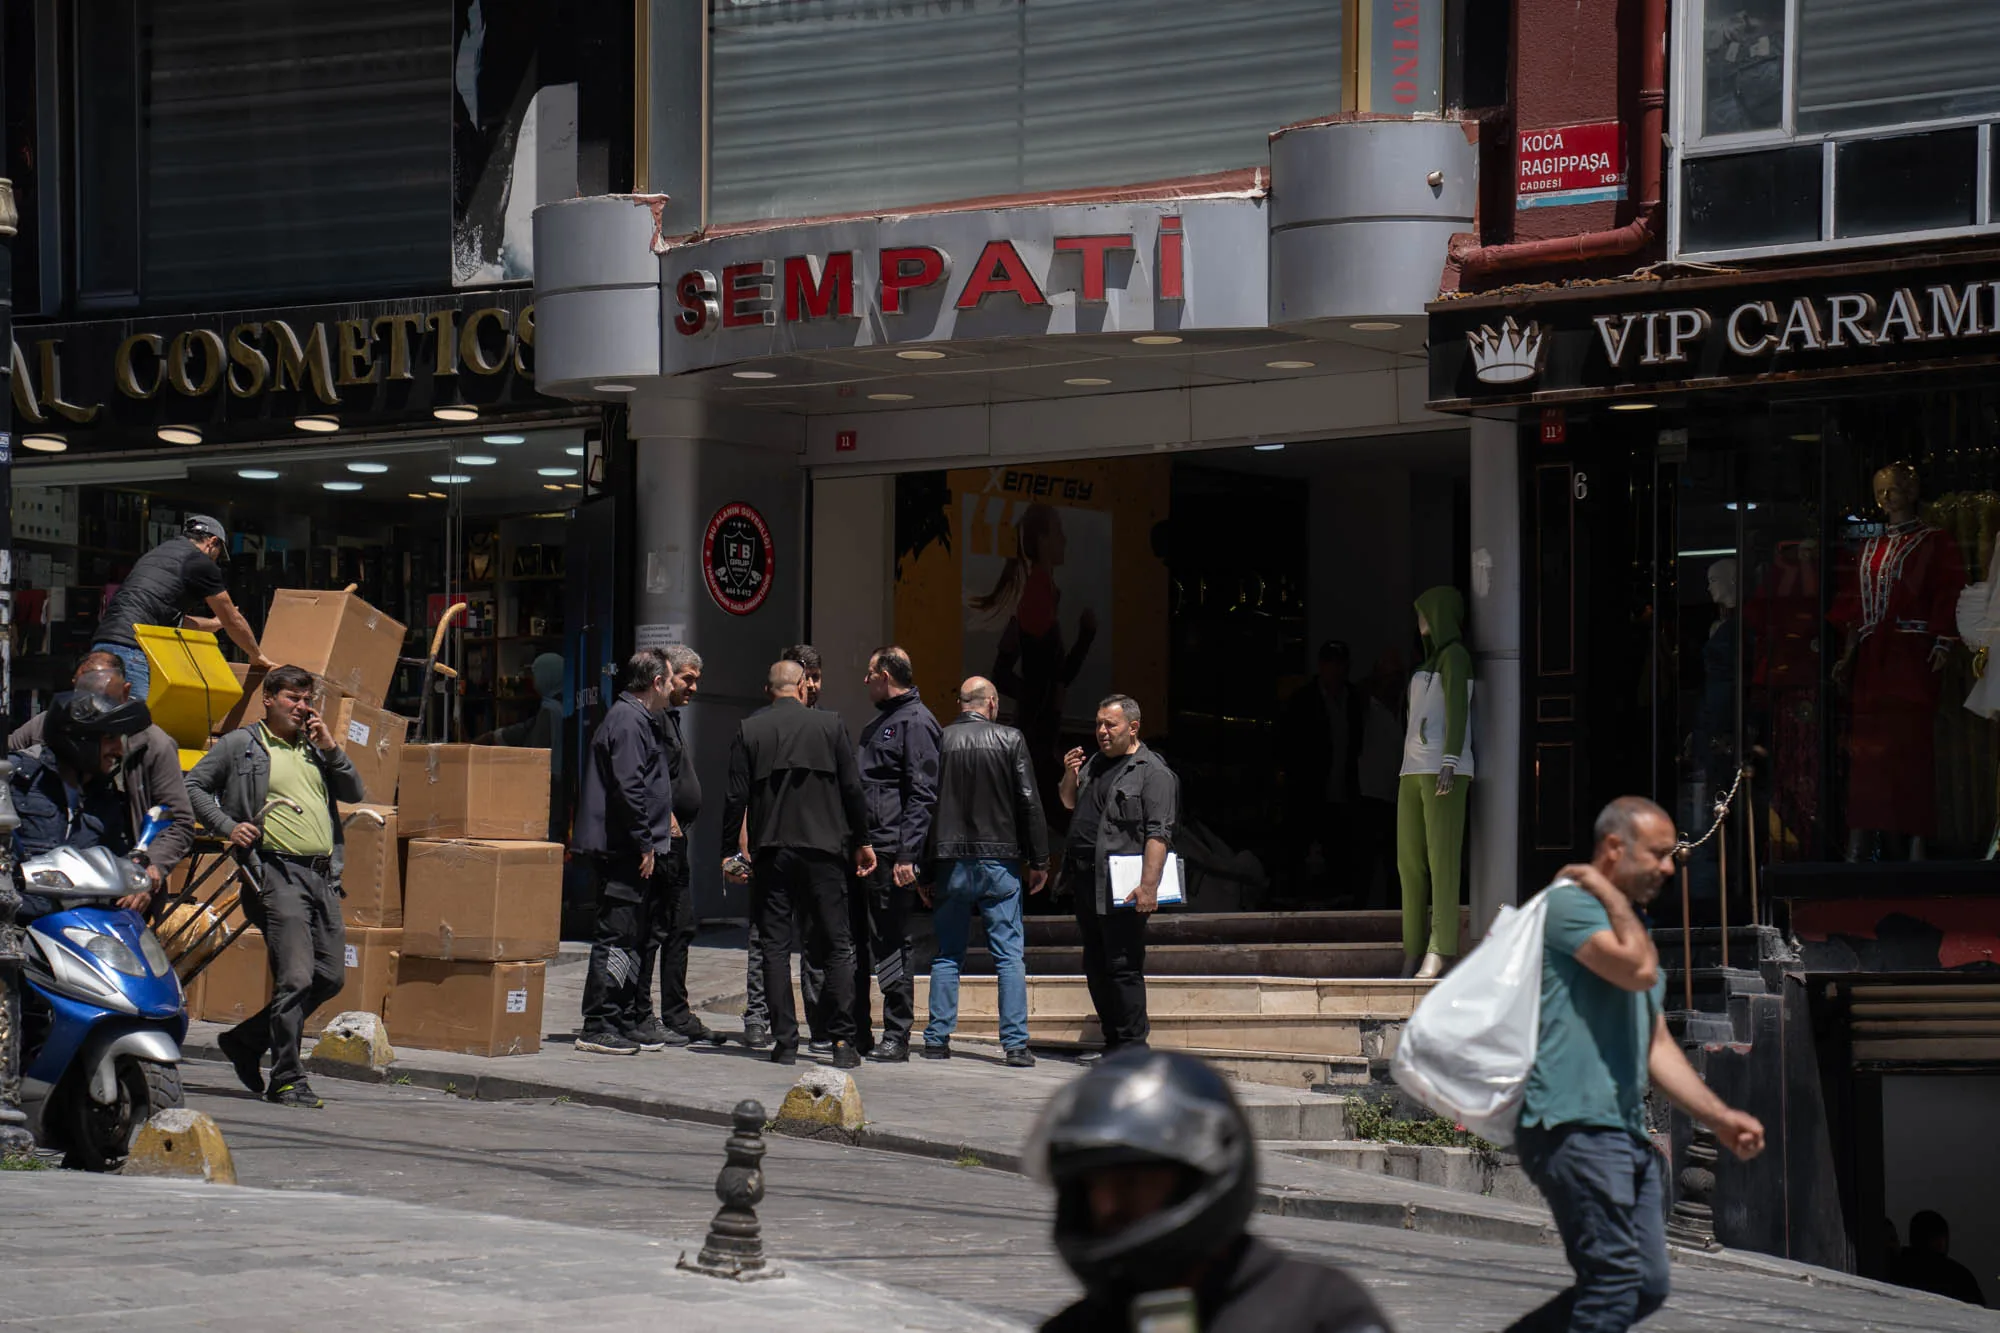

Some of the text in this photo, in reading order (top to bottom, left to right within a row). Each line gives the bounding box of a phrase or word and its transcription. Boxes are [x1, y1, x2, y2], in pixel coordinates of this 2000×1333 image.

[1521, 133, 1564, 153] KOCA
[1521, 152, 1610, 177] RAGIPPAŞA
[674, 214, 1184, 338] SEMPATİ
[1592, 308, 1709, 367] VIP
[841, 436, 850, 447] 11
[1573, 471, 1589, 500] 6
[729, 543, 751, 559] FIB
